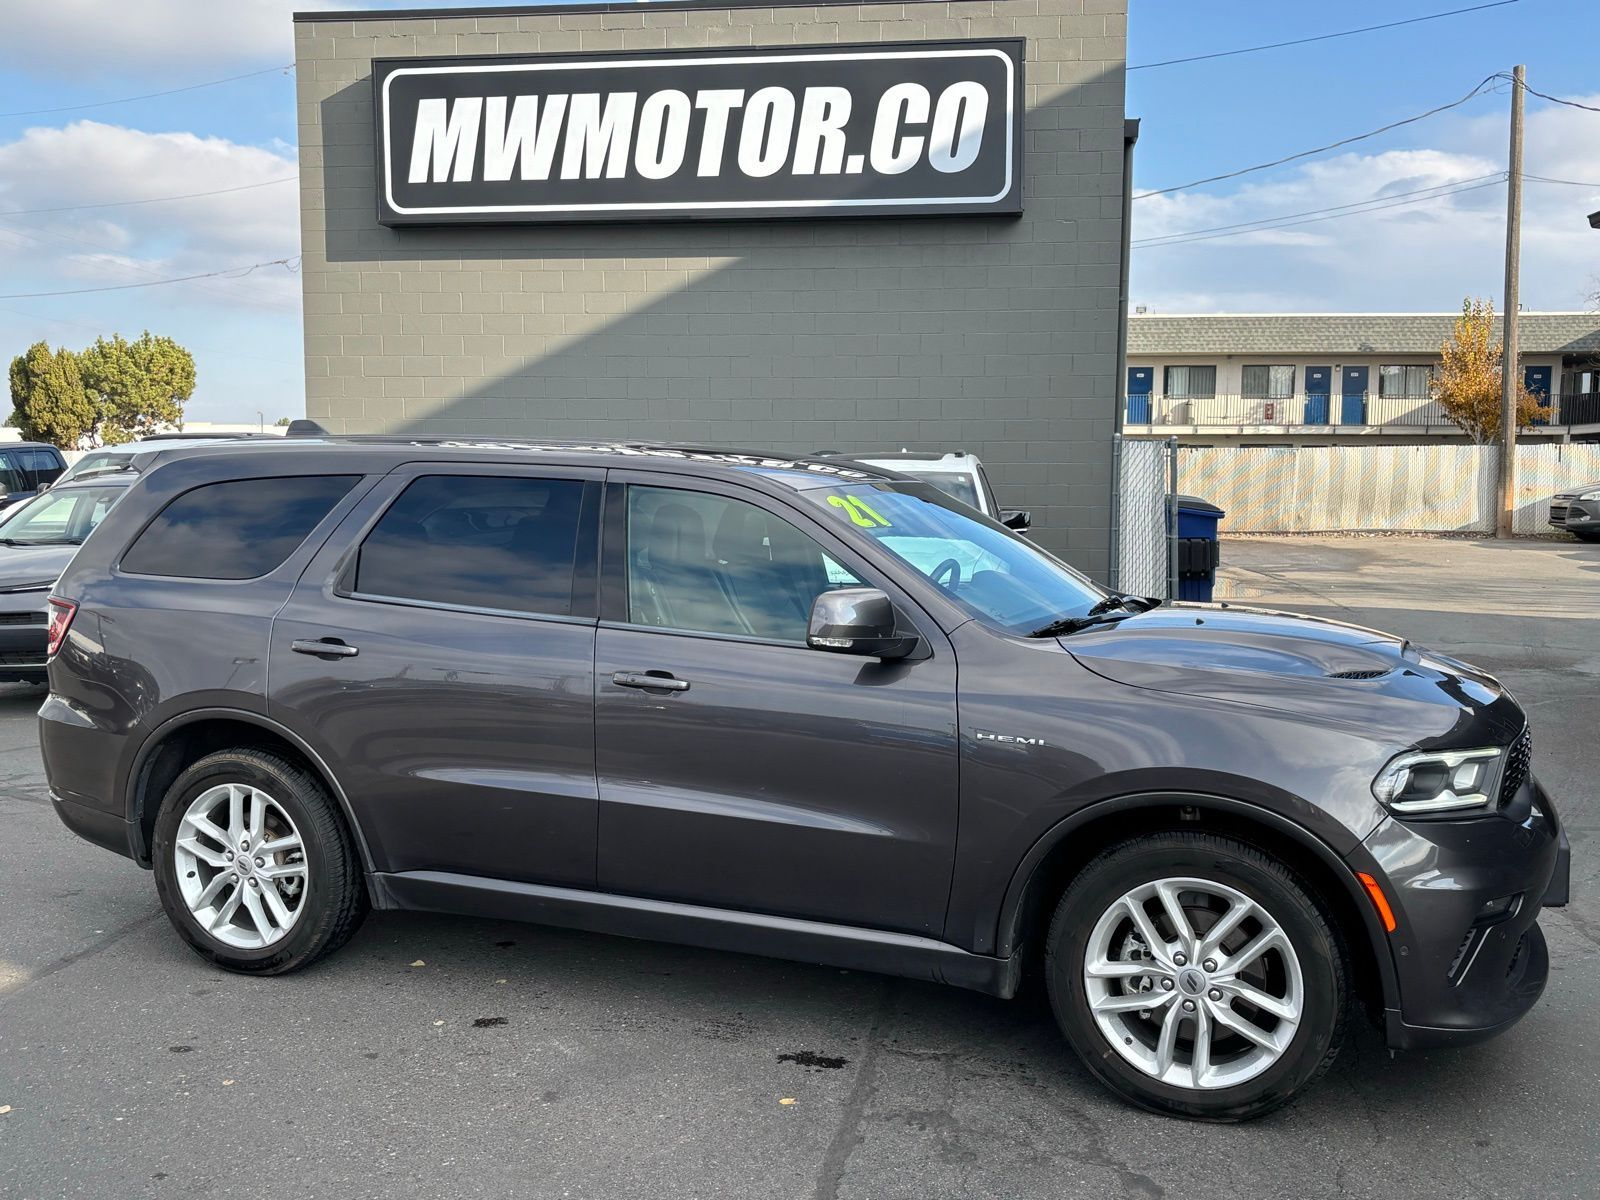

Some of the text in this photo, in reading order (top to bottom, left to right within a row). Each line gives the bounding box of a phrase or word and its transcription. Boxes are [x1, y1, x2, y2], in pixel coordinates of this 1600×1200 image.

[408, 81, 989, 184] MWMOTOR.CO
[826, 494, 892, 528] 21
[976, 733, 1045, 746] HEMI
